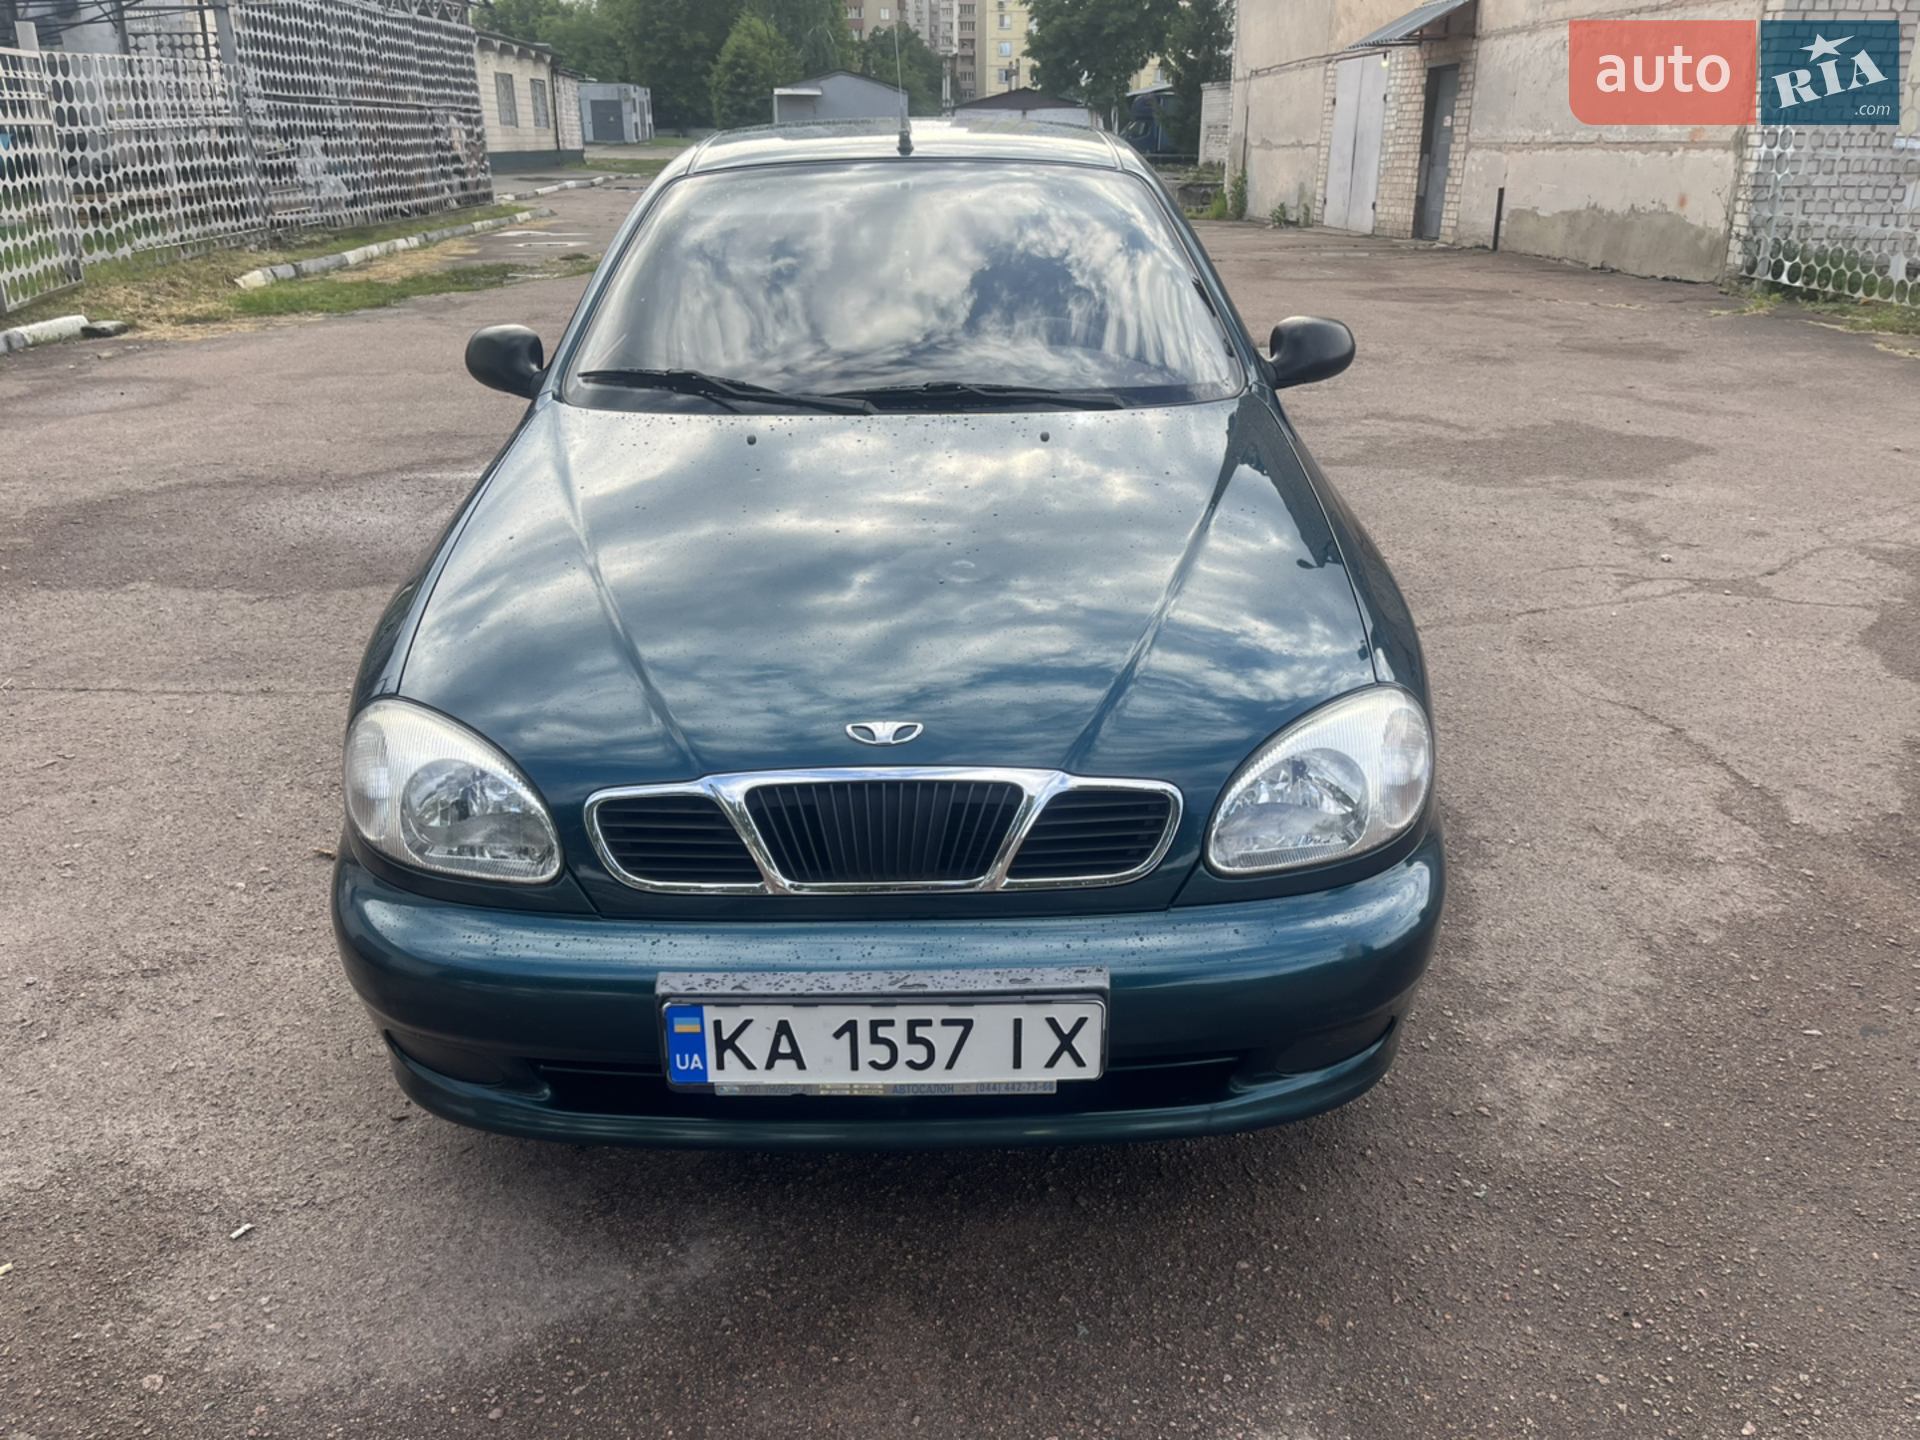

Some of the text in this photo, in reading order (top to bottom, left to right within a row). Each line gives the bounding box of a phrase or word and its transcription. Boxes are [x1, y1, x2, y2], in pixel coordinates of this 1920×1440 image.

[712, 1016, 1089, 1071] KA 1557 IX
[676, 1054, 704, 1071] UA
[891, 1083, 954, 1095] АВТОСАЛОН
[975, 1082, 1001, 1094] (044)
